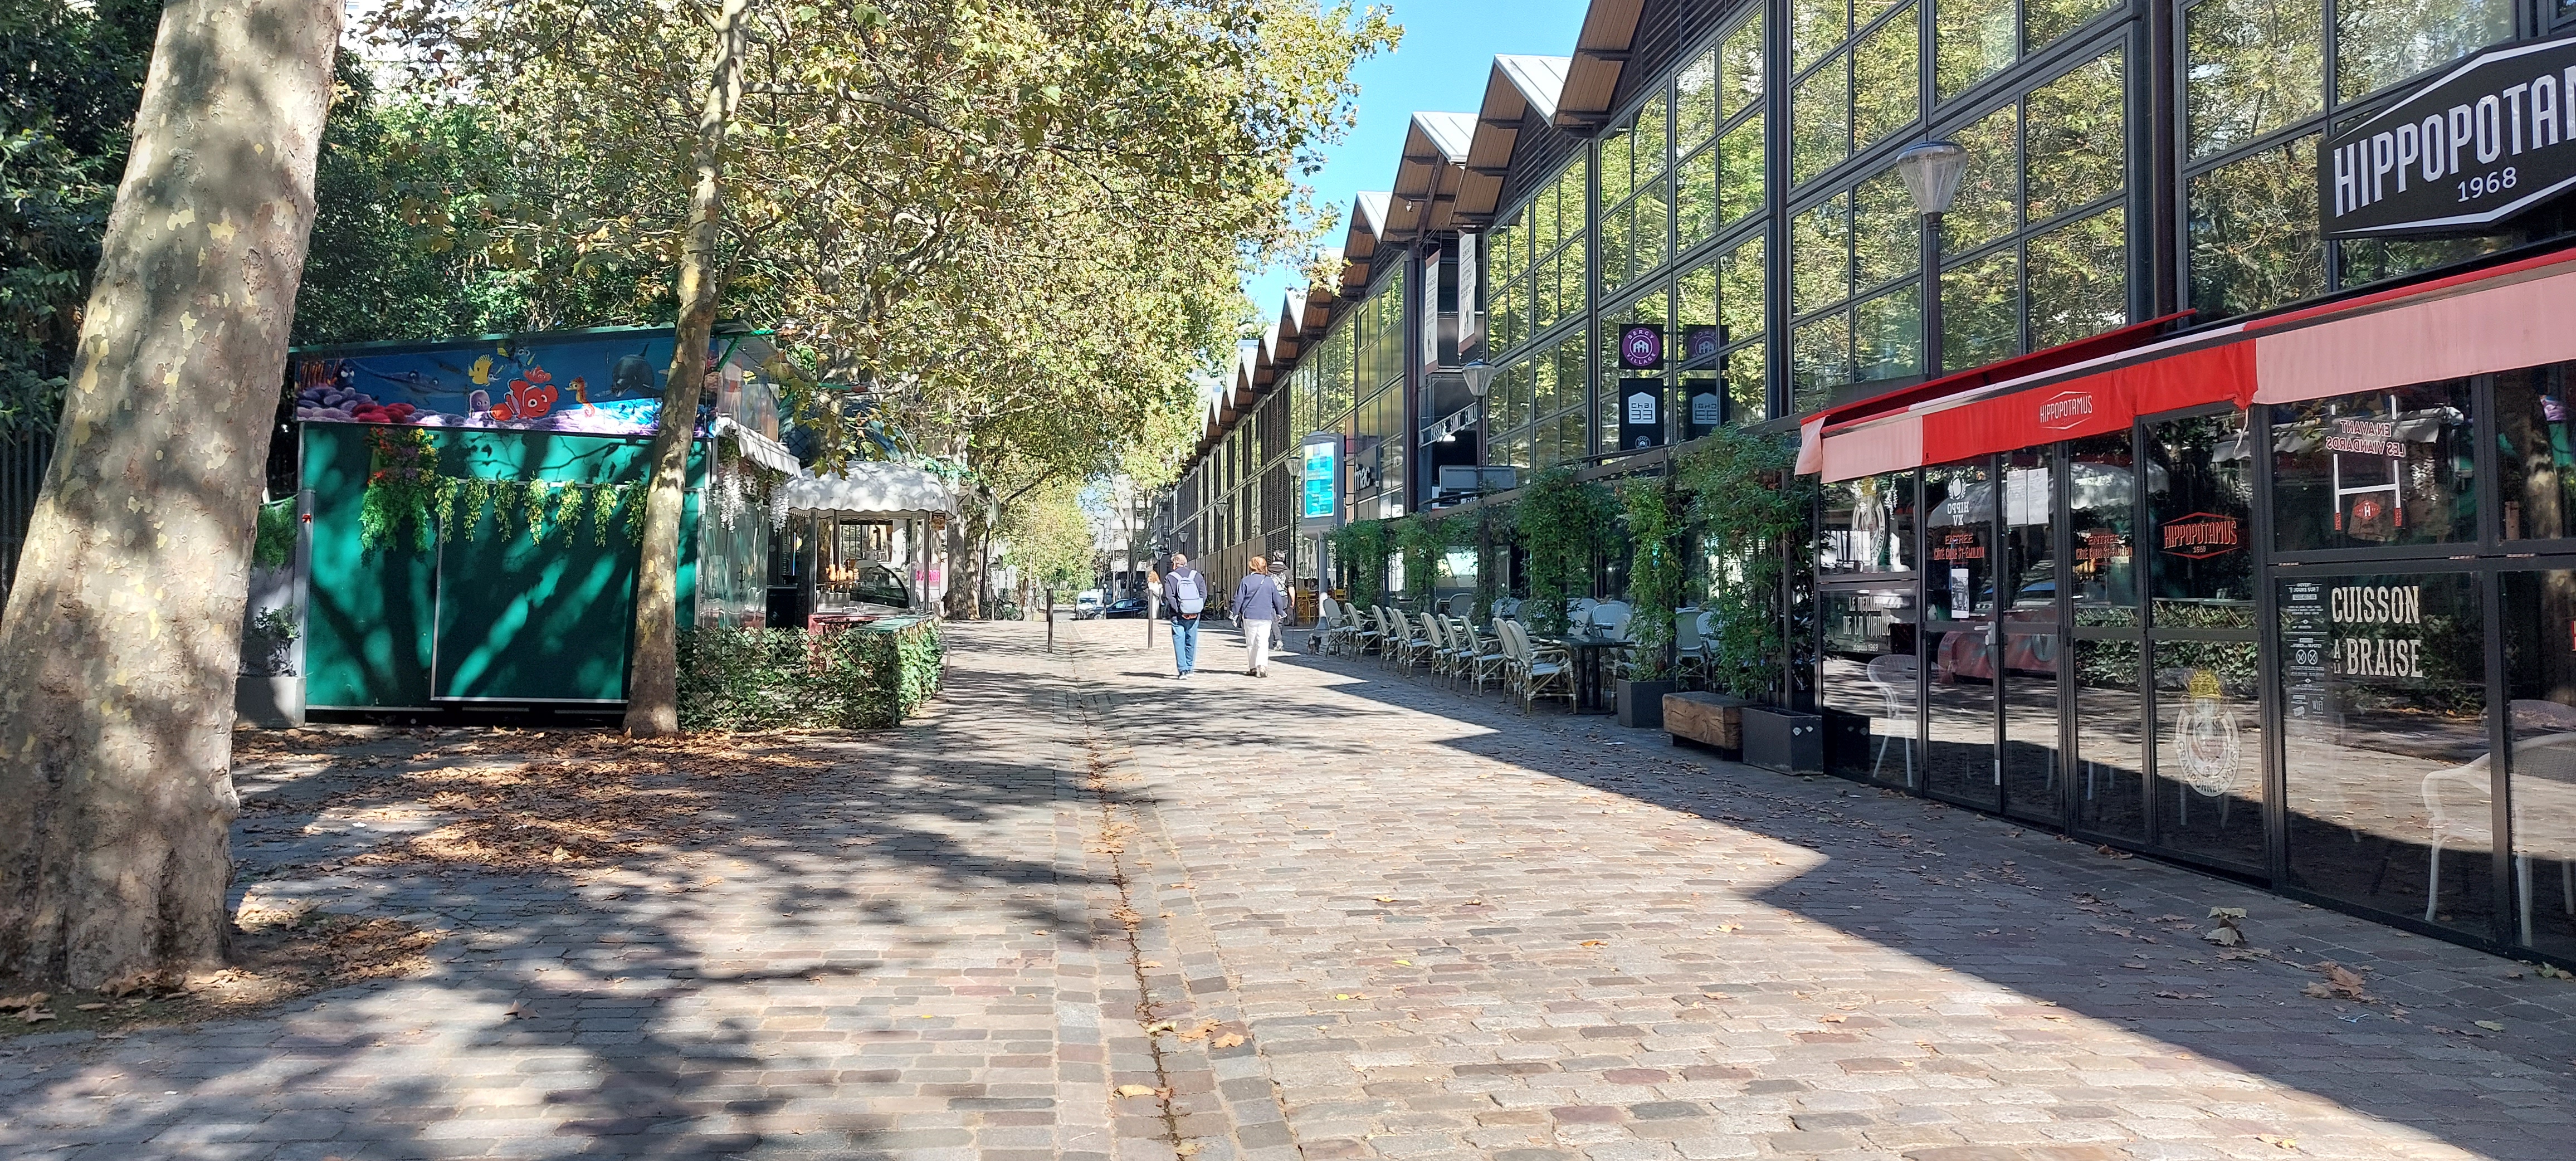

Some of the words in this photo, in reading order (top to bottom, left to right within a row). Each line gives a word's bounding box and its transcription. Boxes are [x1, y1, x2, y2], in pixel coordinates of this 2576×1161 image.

[2457, 167, 2517, 203] 1968
[1628, 329, 1655, 340] BERCY
[1627, 353, 1657, 364] VILLAGE
[2040, 394, 2092, 423] HIPPOPOTAMUS
[1431, 421, 1447, 441] PASSAGE
[1450, 413, 1461, 432] SAINT
[1354, 464, 1370, 491] fnac
[2364, 505, 2371, 517] H
[2163, 521, 2237, 549] HIPPOPOTAMUS
[1849, 597, 1856, 611] LE
[2331, 585, 2420, 624] CUISSON
[1843, 616, 1852, 635] DE
[1855, 616, 1863, 637] LA
[1866, 613, 1891, 638] VIANDE
[2333, 662, 2341, 674] LA
[2346, 638, 2423, 677] BRAISE
